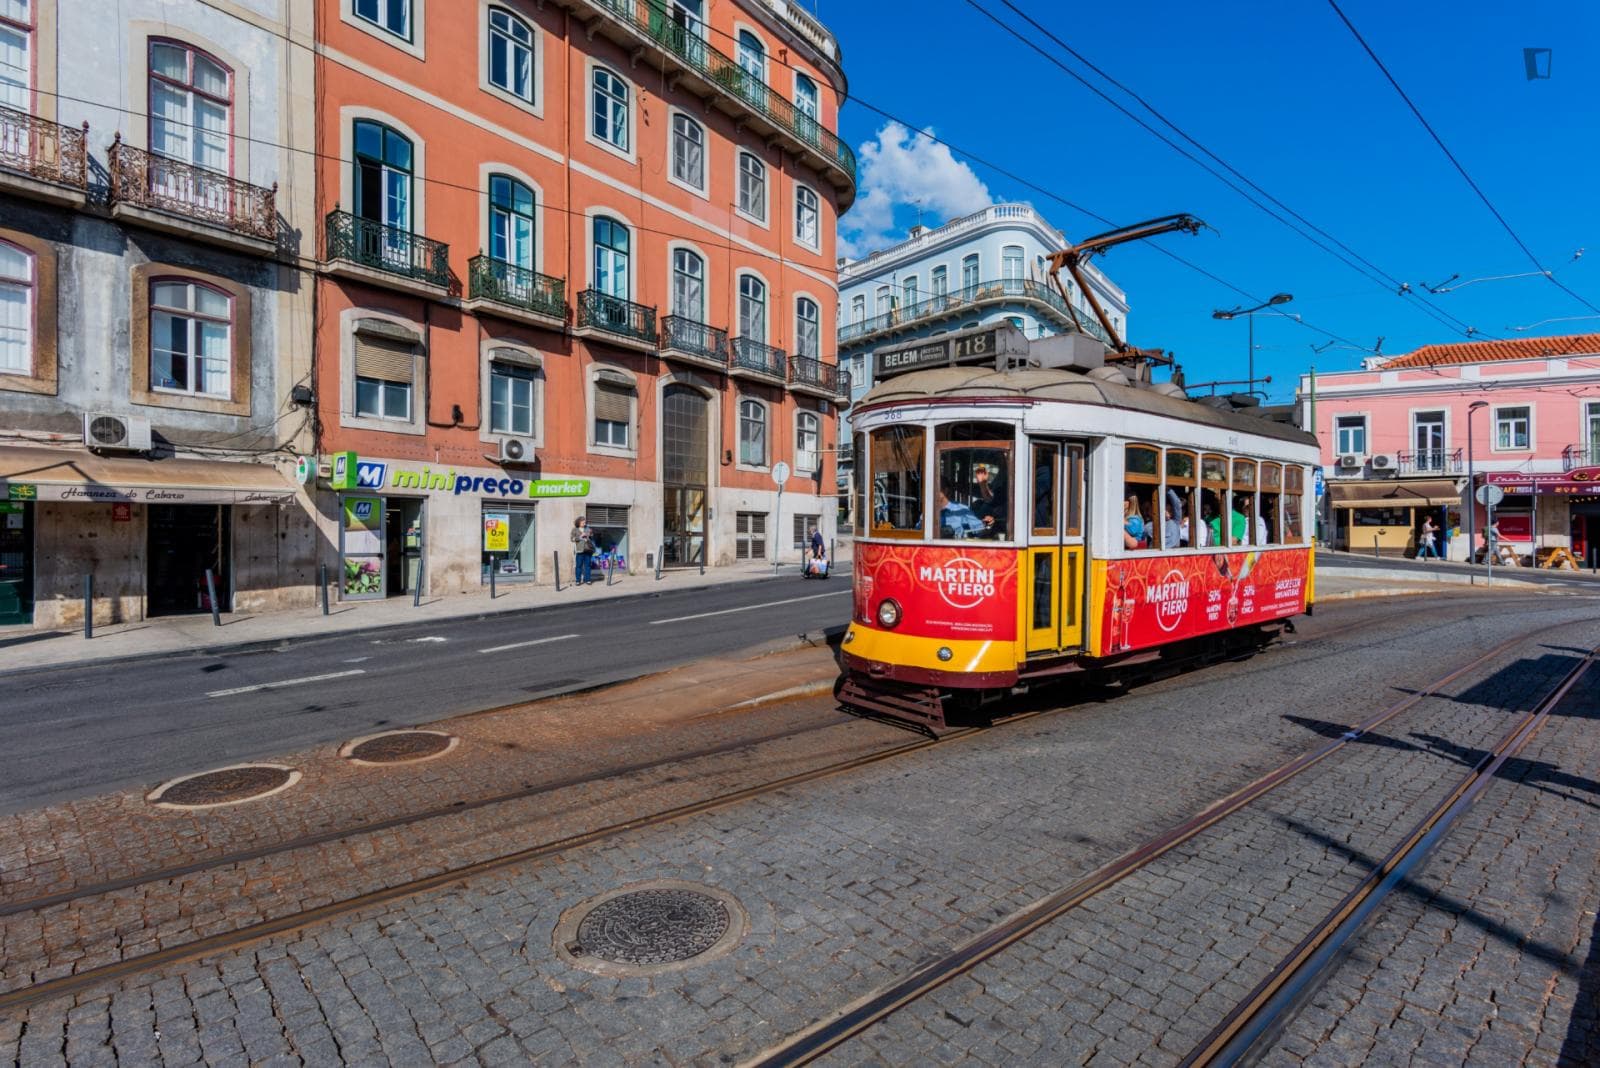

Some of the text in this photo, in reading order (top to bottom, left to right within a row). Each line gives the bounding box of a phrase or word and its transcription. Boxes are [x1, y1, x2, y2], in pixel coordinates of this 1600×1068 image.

[537, 477, 583, 493] market
[920, 566, 994, 584] MARTINI
[948, 582, 995, 596] FIERO
[1146, 580, 1190, 604] MARTINI
[1162, 598, 1188, 617] FIERO
